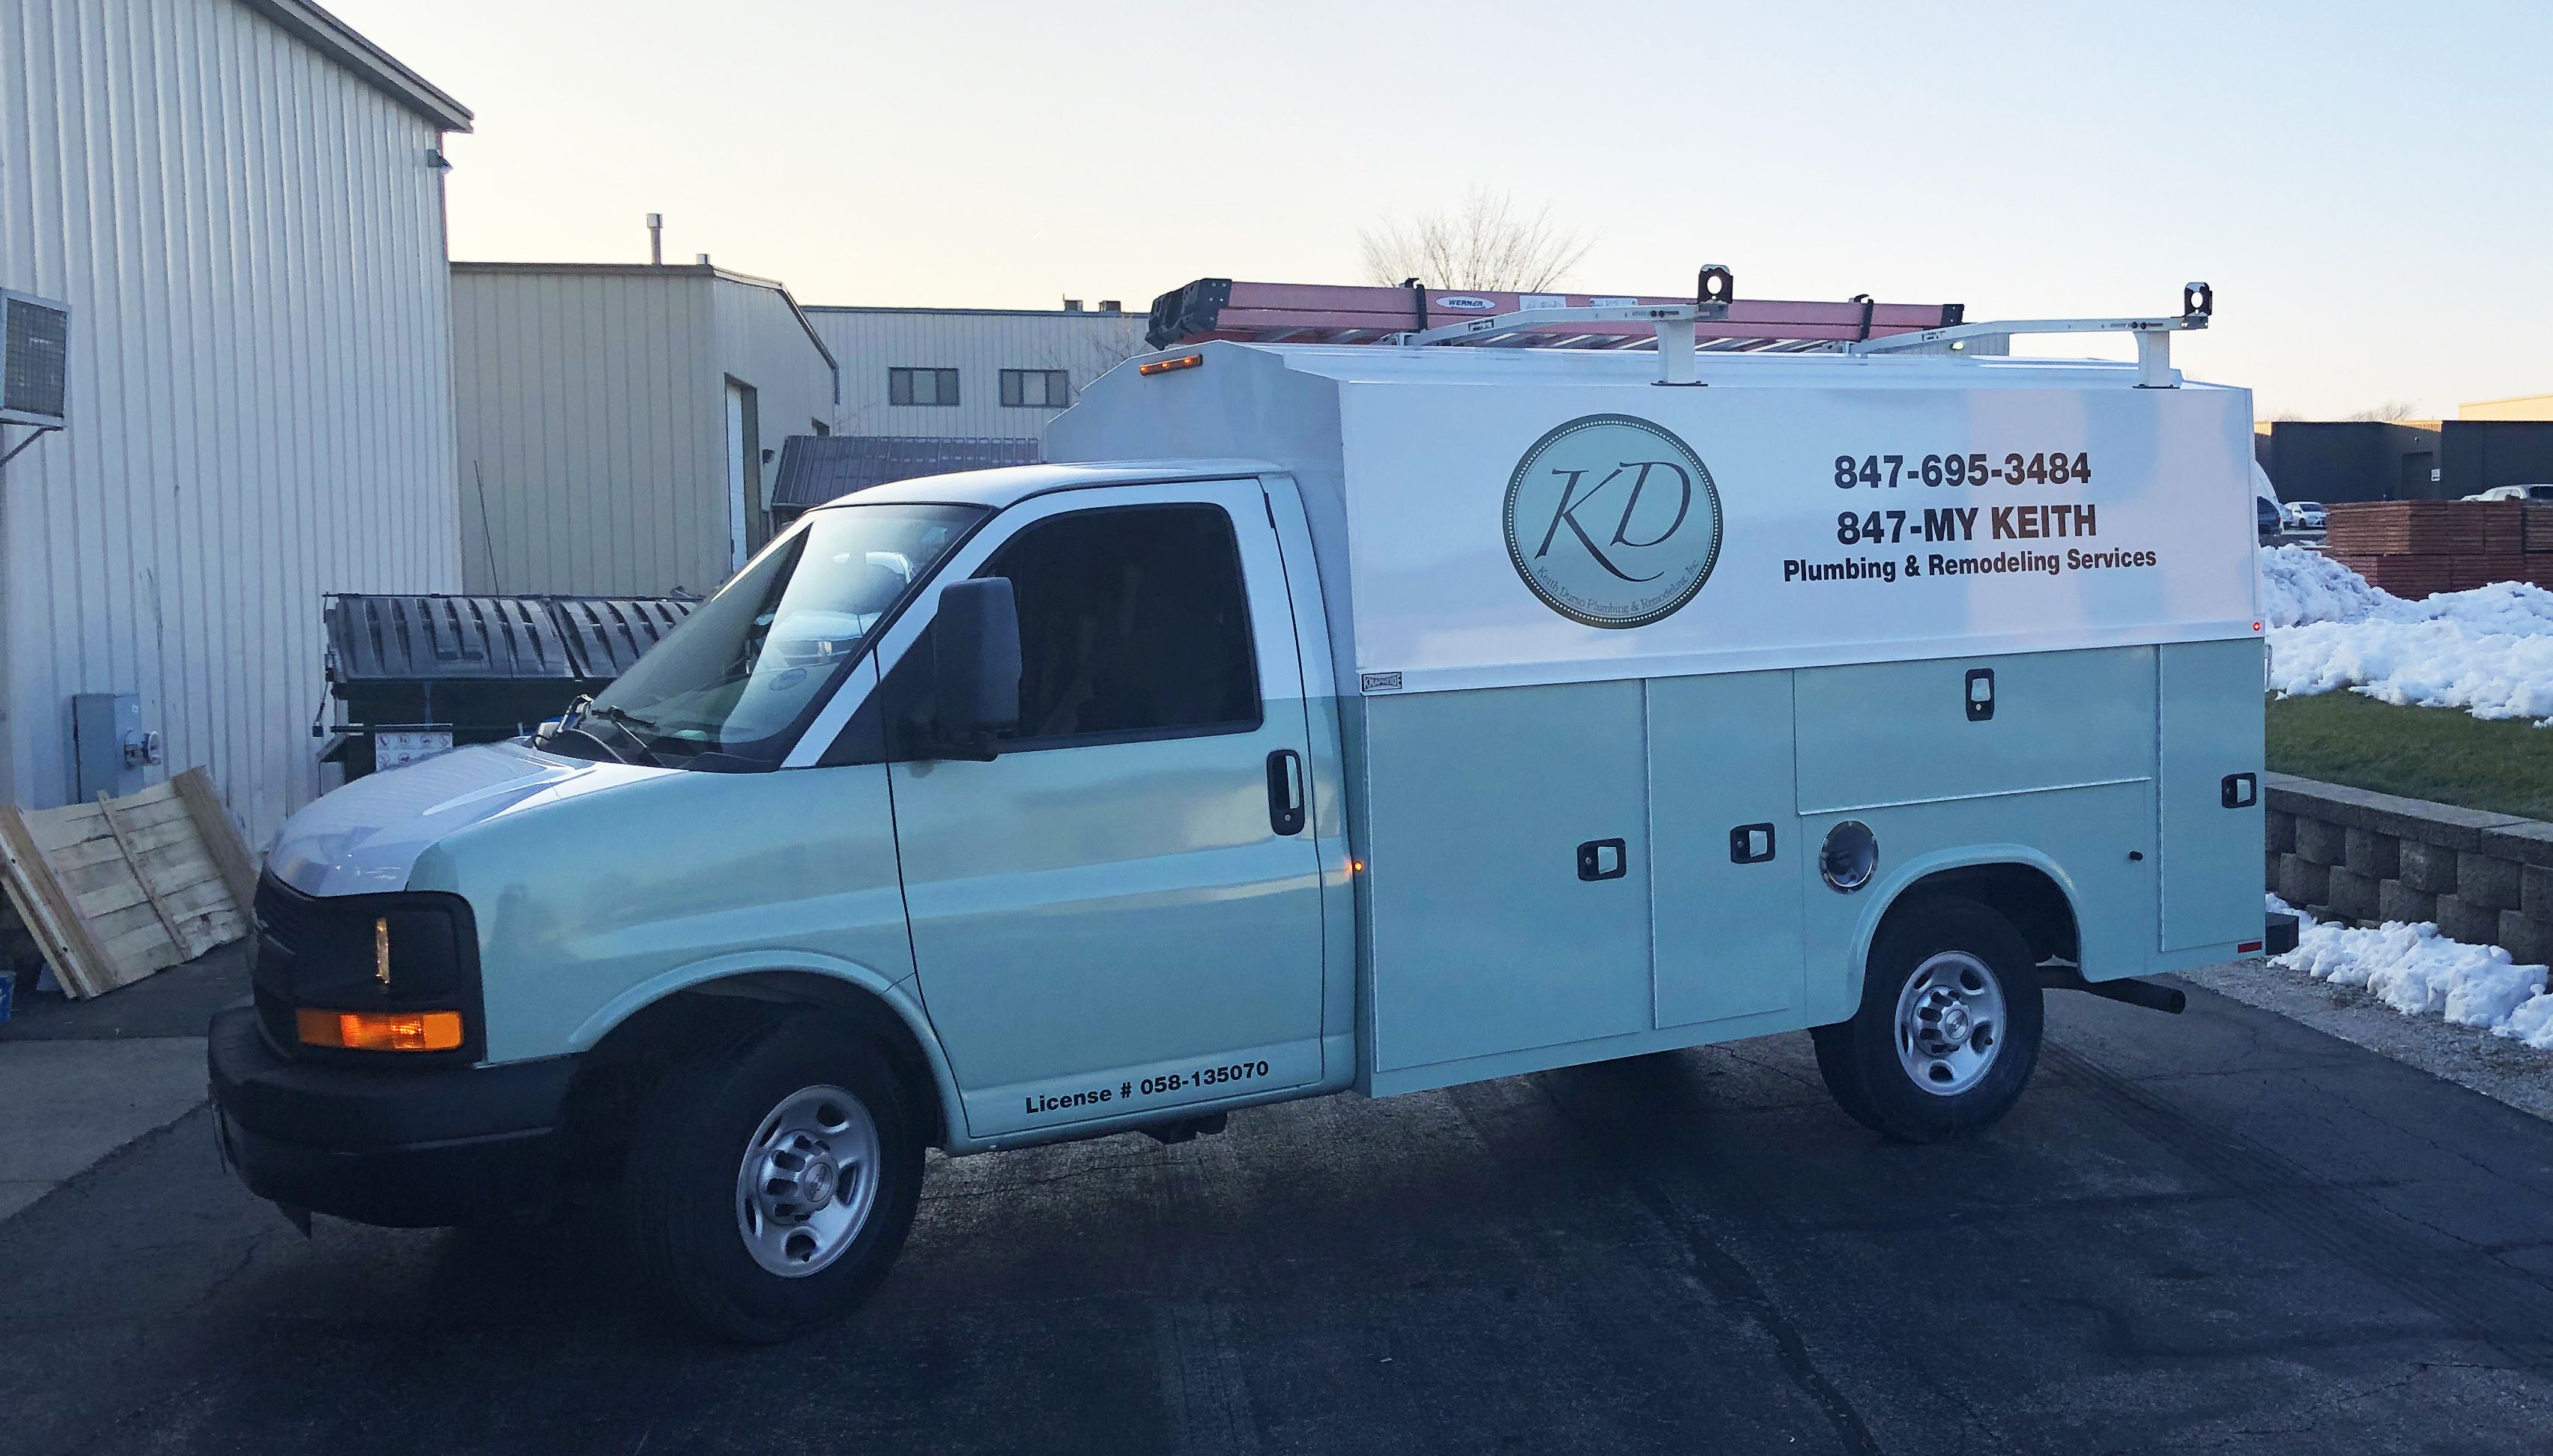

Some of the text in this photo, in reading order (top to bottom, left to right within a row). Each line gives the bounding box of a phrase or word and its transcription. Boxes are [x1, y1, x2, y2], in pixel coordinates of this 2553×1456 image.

[1834, 452, 2092, 488] 847-695-3484
[1534, 461, 1692, 582] KD
[1837, 504, 2097, 545] 847-MY KEITH
[1784, 547, 2157, 583] Plumbing & Remodeling Services
[1026, 1061, 1269, 1114] License # 058-135070
